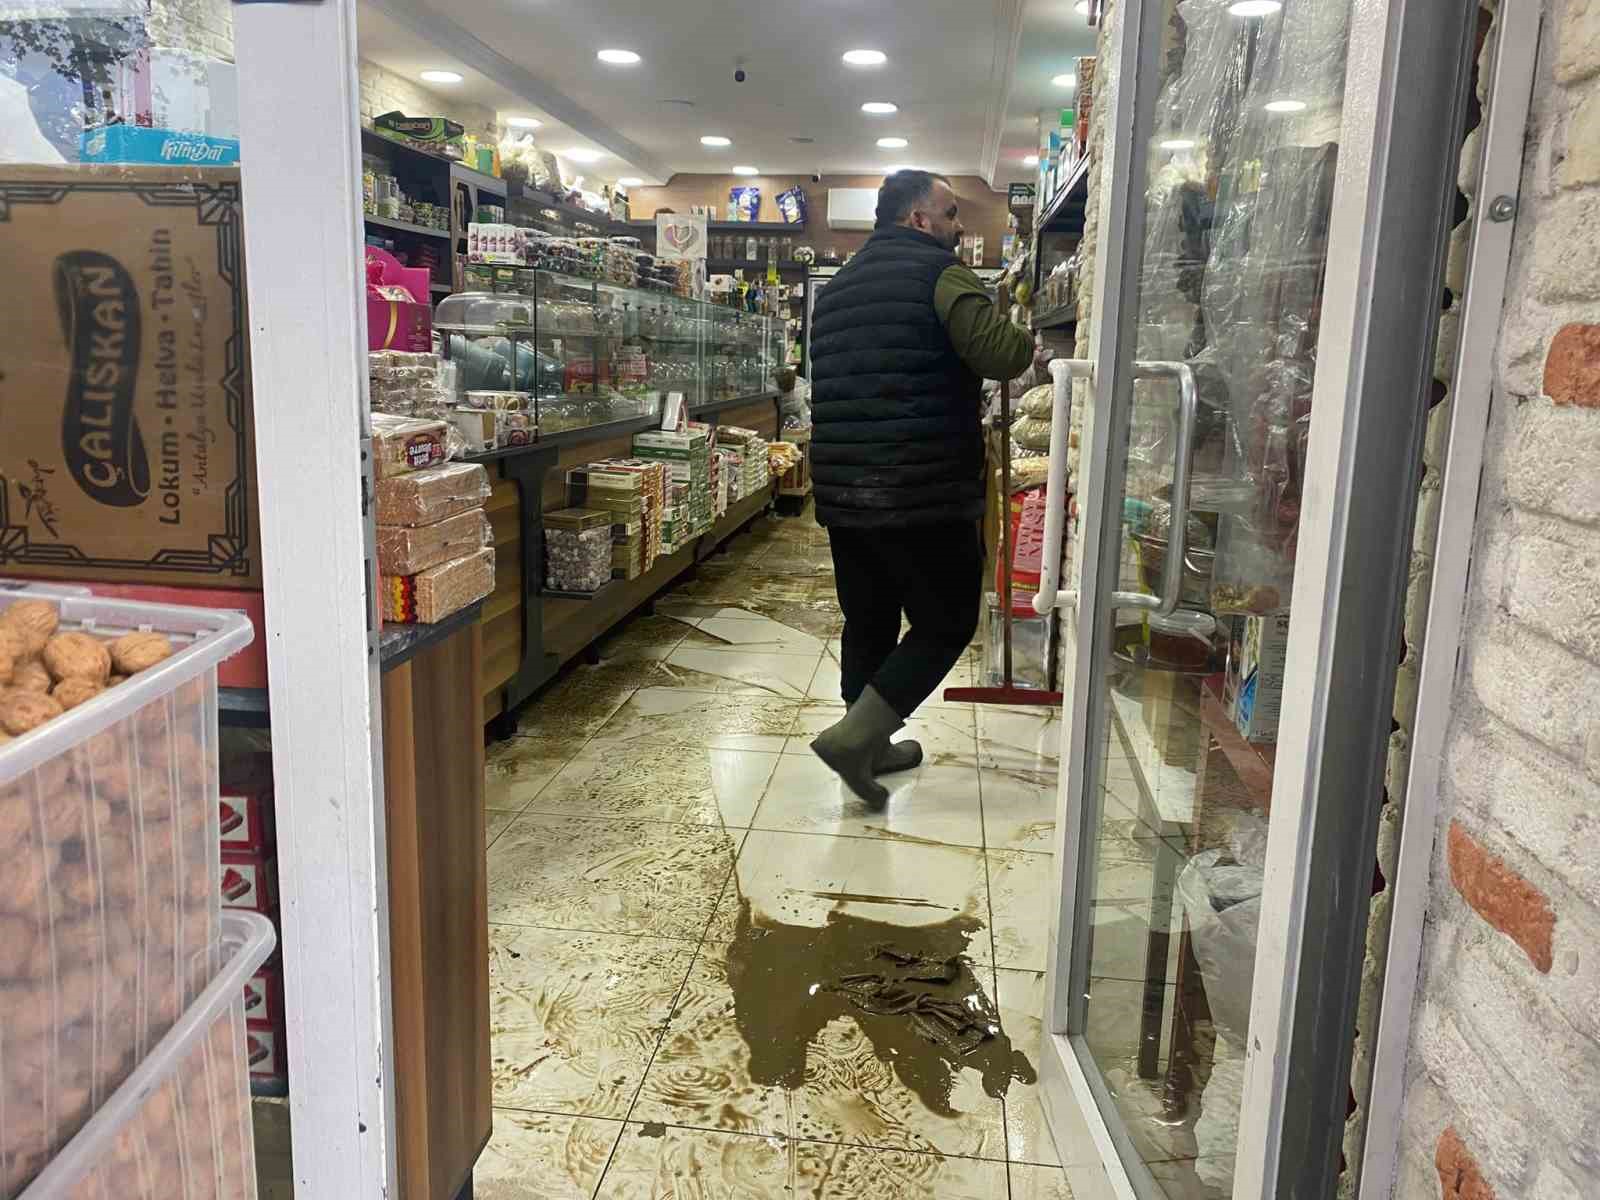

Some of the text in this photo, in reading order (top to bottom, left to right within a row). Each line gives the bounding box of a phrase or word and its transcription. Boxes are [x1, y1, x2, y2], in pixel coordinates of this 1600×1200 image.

[149, 228, 180, 525] Lokum Helva Tahin
